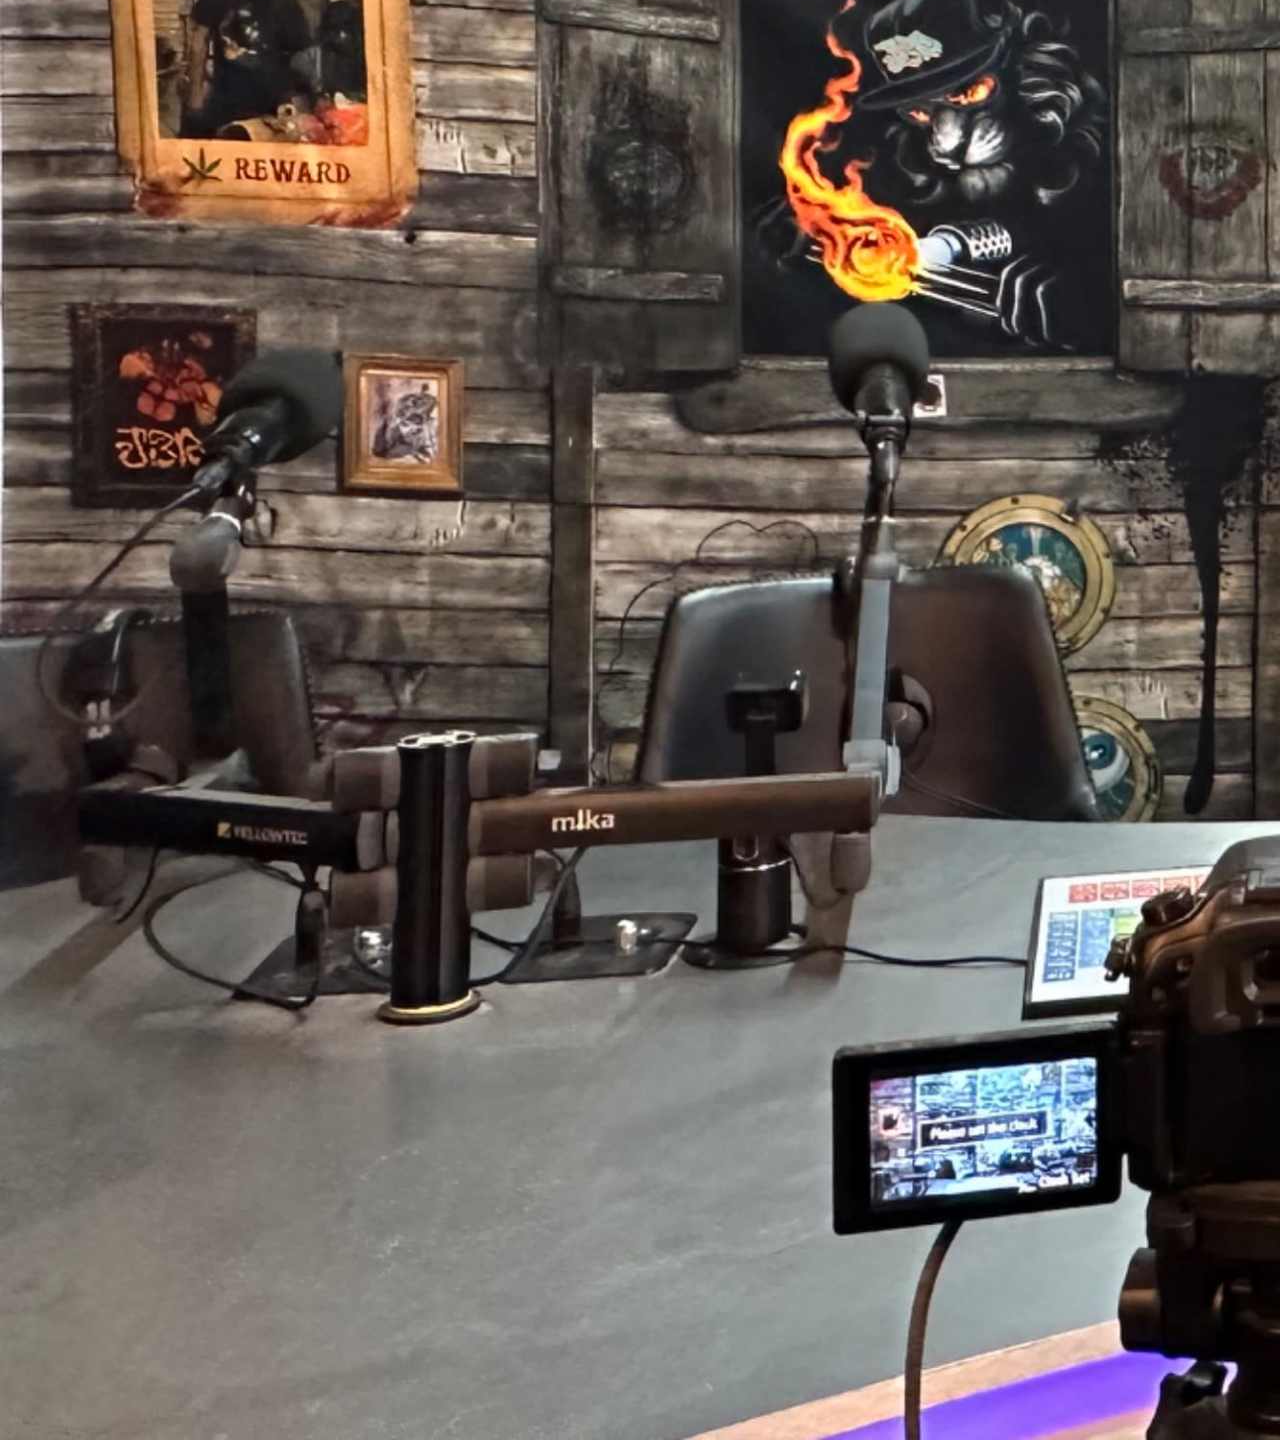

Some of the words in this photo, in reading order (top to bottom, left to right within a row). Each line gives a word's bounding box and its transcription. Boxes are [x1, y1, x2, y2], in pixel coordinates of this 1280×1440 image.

[235, 158, 351, 185] REWARD
[552, 808, 616, 833] mika
[233, 823, 309, 846] YELLOWTEC
